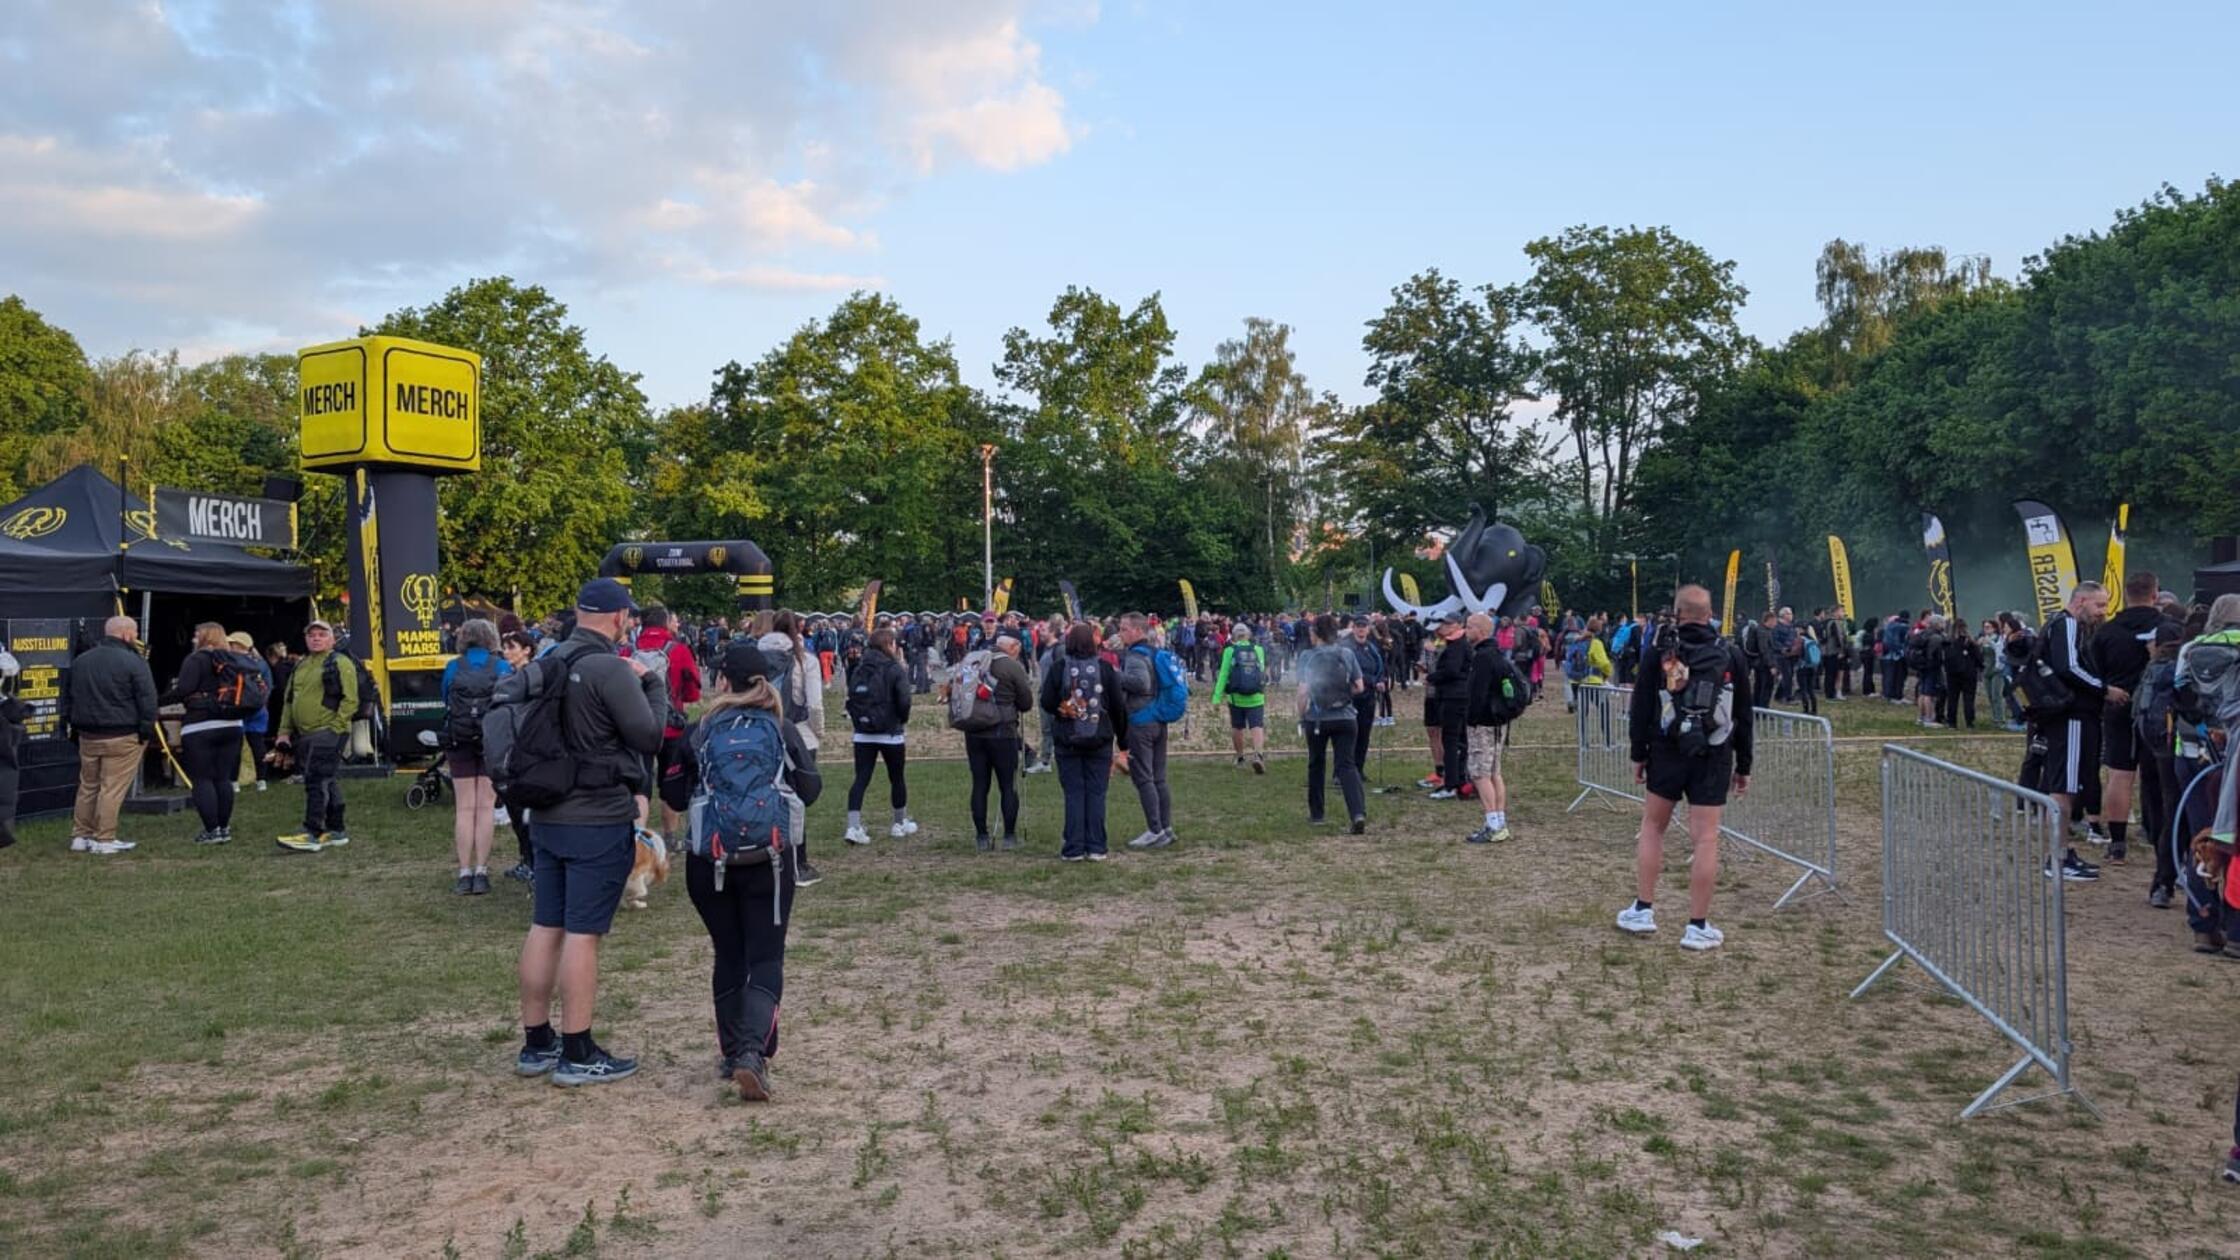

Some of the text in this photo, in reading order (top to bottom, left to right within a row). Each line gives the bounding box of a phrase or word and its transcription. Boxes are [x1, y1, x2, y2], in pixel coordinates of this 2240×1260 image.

[303, 381, 355, 416] MERCH
[396, 383, 468, 420] MERCH
[188, 497, 262, 540] MERCH
[13, 638, 68, 651] AUSSTELLUNG
